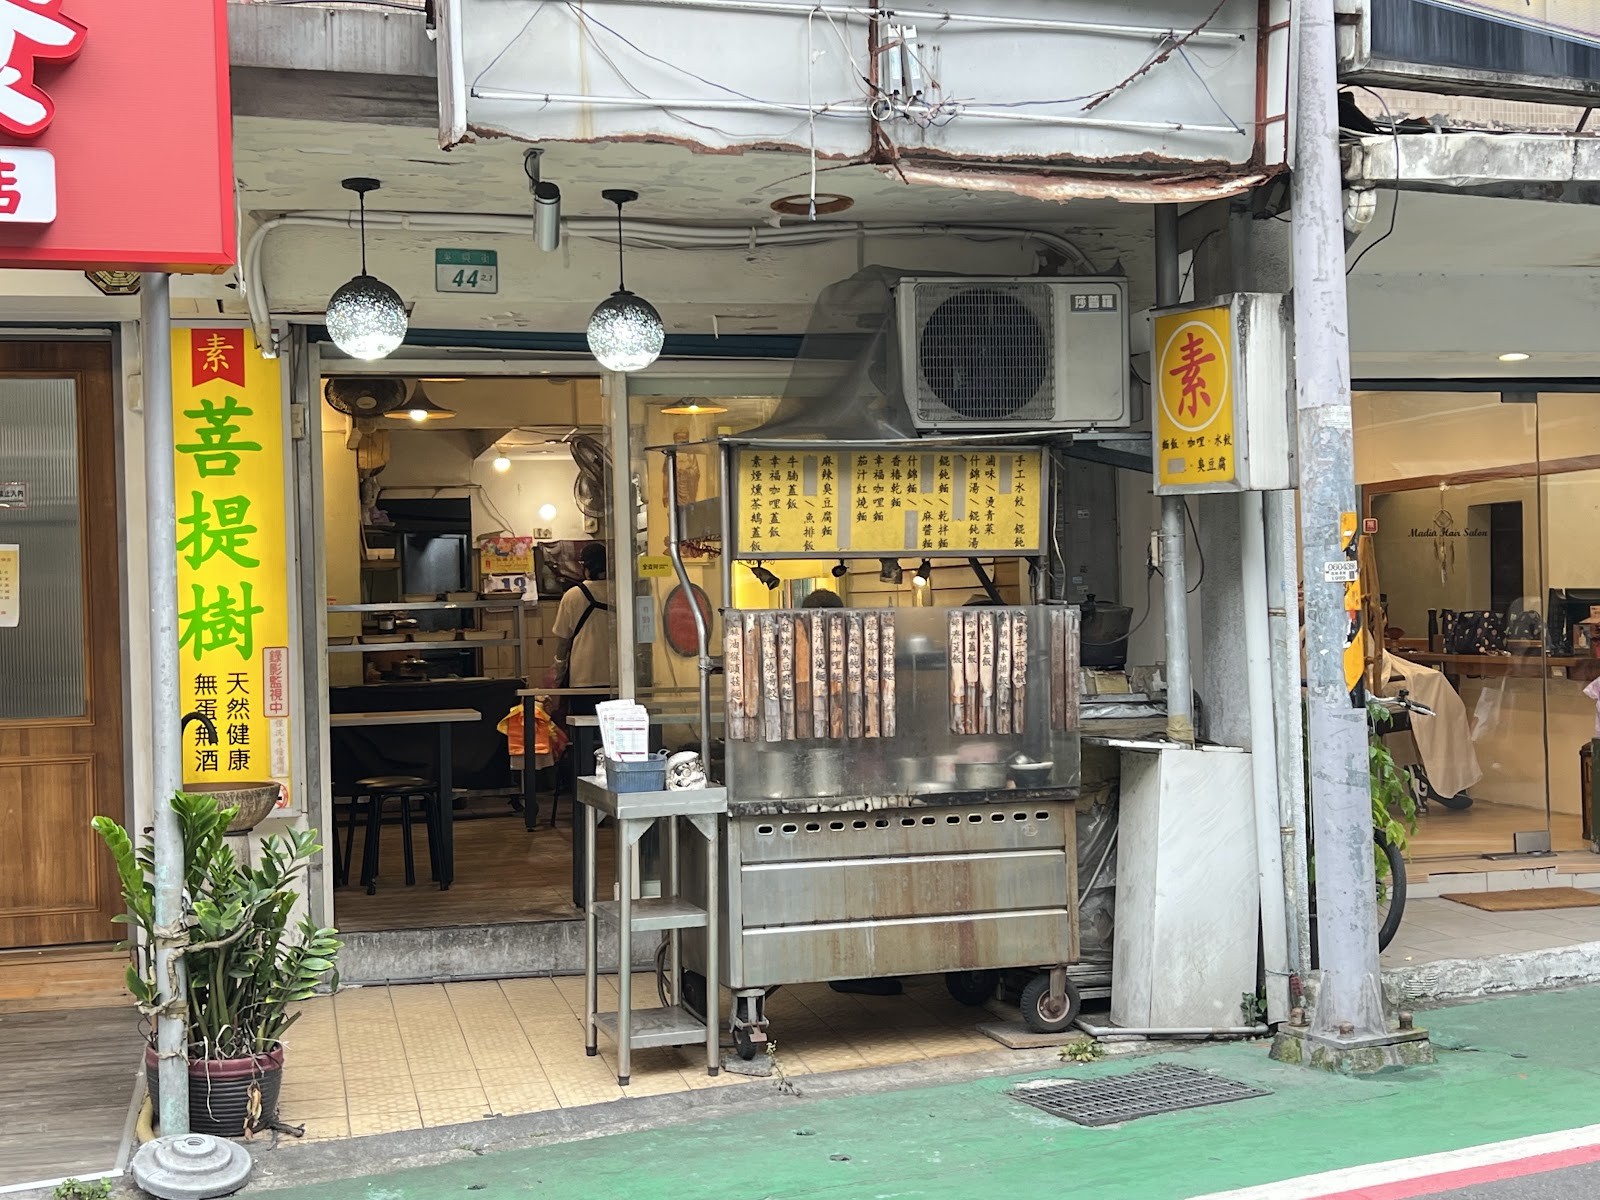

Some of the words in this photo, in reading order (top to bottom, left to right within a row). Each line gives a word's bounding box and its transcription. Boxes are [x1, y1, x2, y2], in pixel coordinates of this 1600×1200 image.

[197, 334, 234, 372] 素
[1169, 332, 1216, 418] 素
[768, 455, 781, 537] 幸福咖哩蓋飯
[786, 455, 799, 509] 牛腩蓋飯
[873, 454, 885, 523] 幸福咖哩麵
[1197, 456, 1227, 473] 臭豆腐
[175, 395, 264, 661] 菩提樹
[1439, 527, 1461, 537] Hair
[1463, 528, 1488, 537] Salon
[269, 650, 283, 714] 錄影監視中
[194, 672, 219, 772] 無蛋無酒
[226, 672, 251, 771] 天然健康
